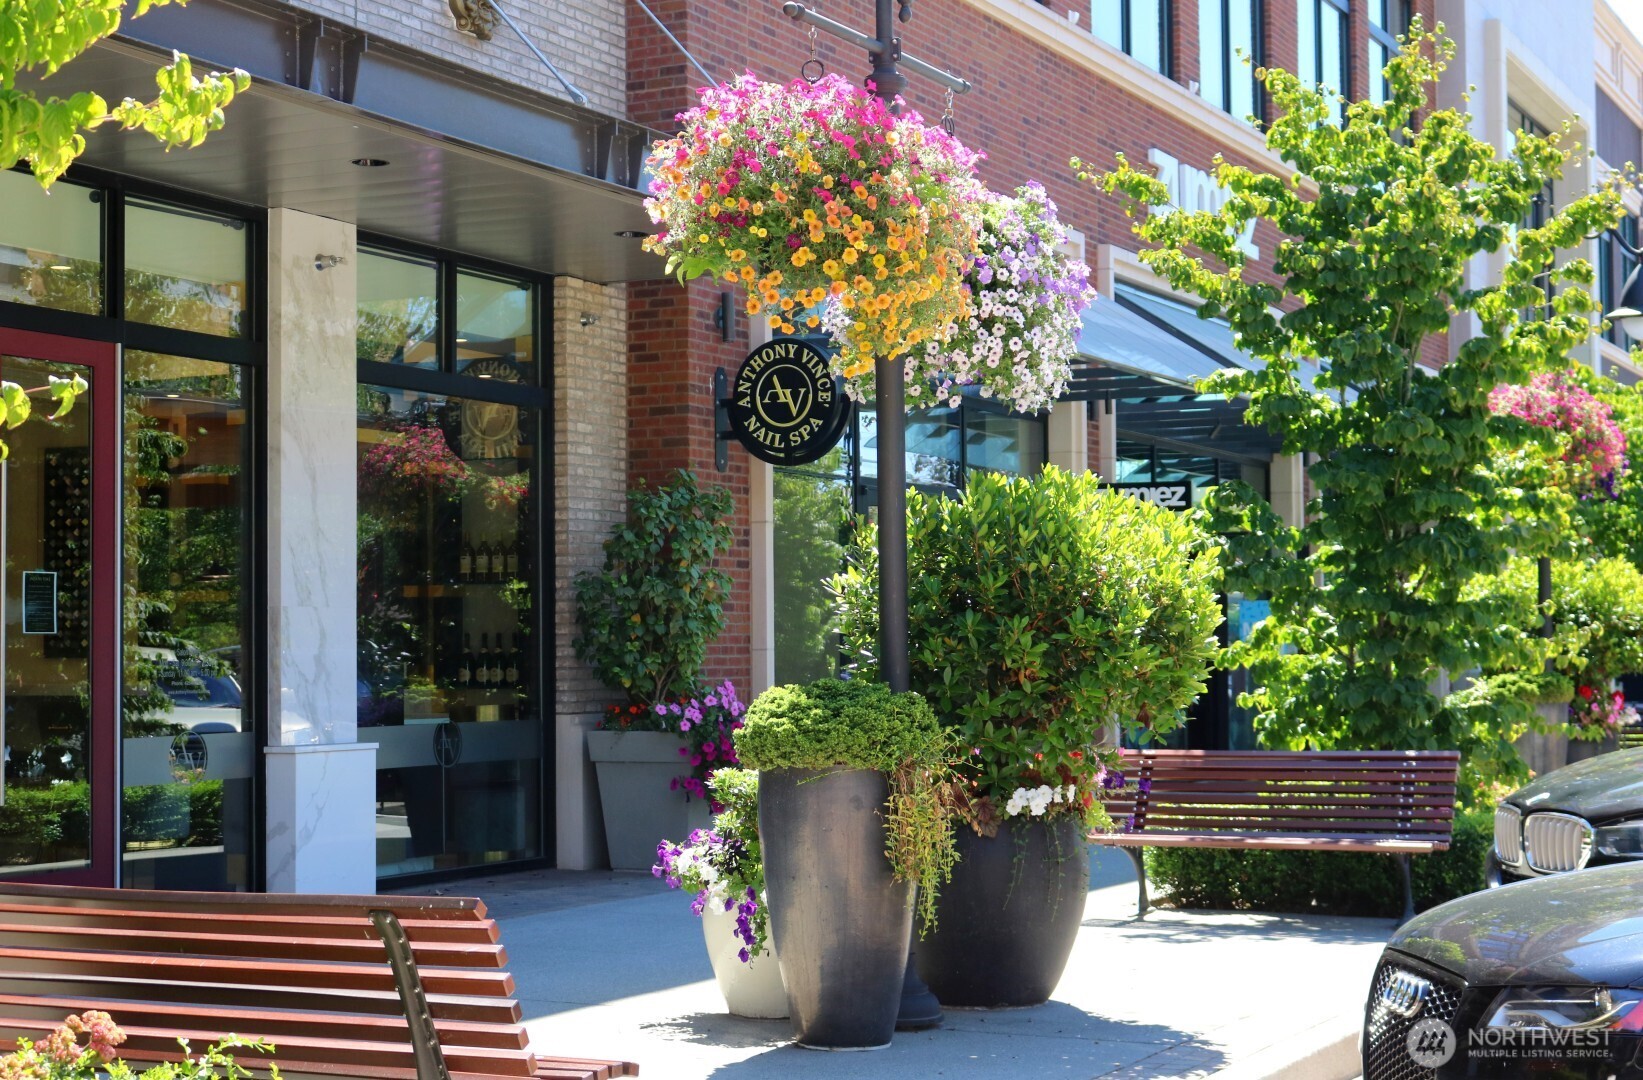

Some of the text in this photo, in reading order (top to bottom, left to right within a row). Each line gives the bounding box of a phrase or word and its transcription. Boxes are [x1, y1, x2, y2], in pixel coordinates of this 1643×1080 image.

[737, 343, 799, 409] ANTHONY
[762, 374, 807, 418] AV
[743, 414, 824, 449] NAIL SPA
